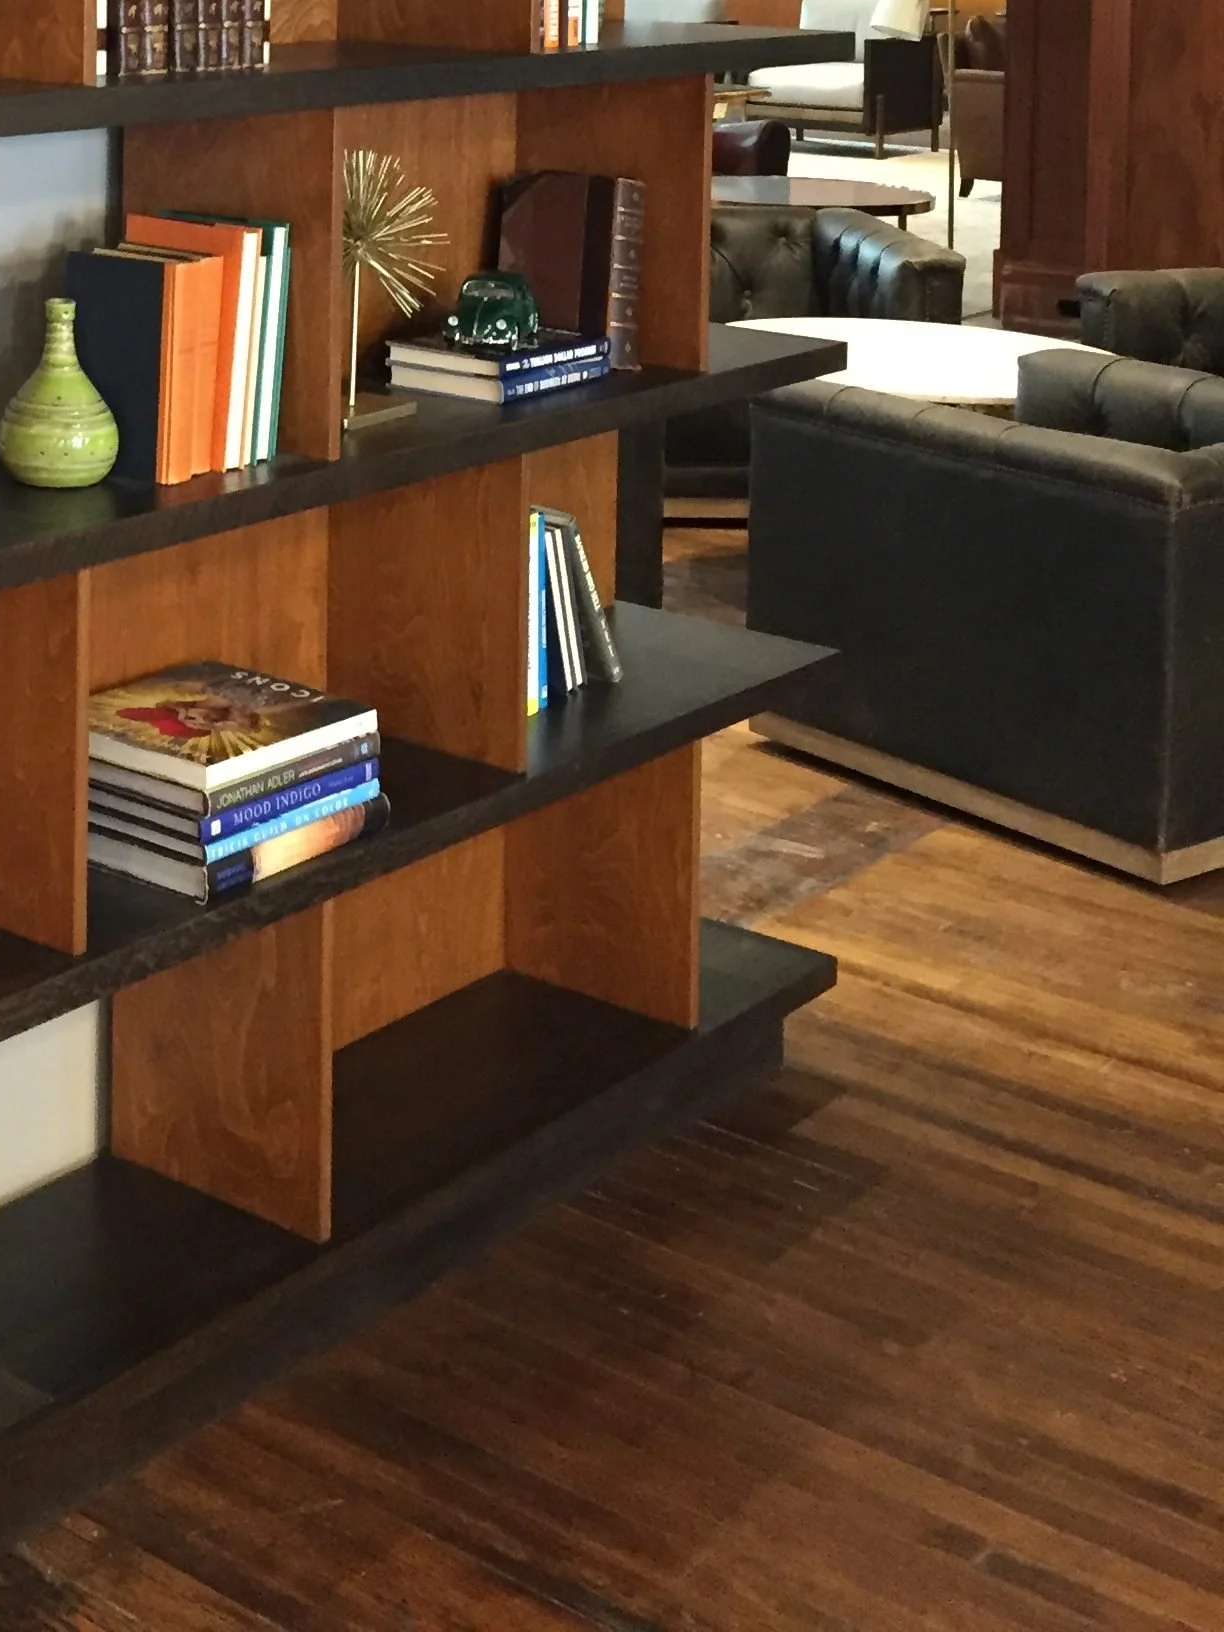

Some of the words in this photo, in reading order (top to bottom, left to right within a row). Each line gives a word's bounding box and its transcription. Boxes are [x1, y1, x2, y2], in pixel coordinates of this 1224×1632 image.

[230, 671, 325, 703] ICONS
[216, 782, 265, 810] JONATHAN
[267, 770, 296, 790] ADLER
[232, 800, 272, 826] MOOD
[275, 783, 322, 810] INDIGO
[211, 835, 249, 857] TRICIA
[254, 821, 288, 842] GUILD
[294, 813, 310, 825] ON
